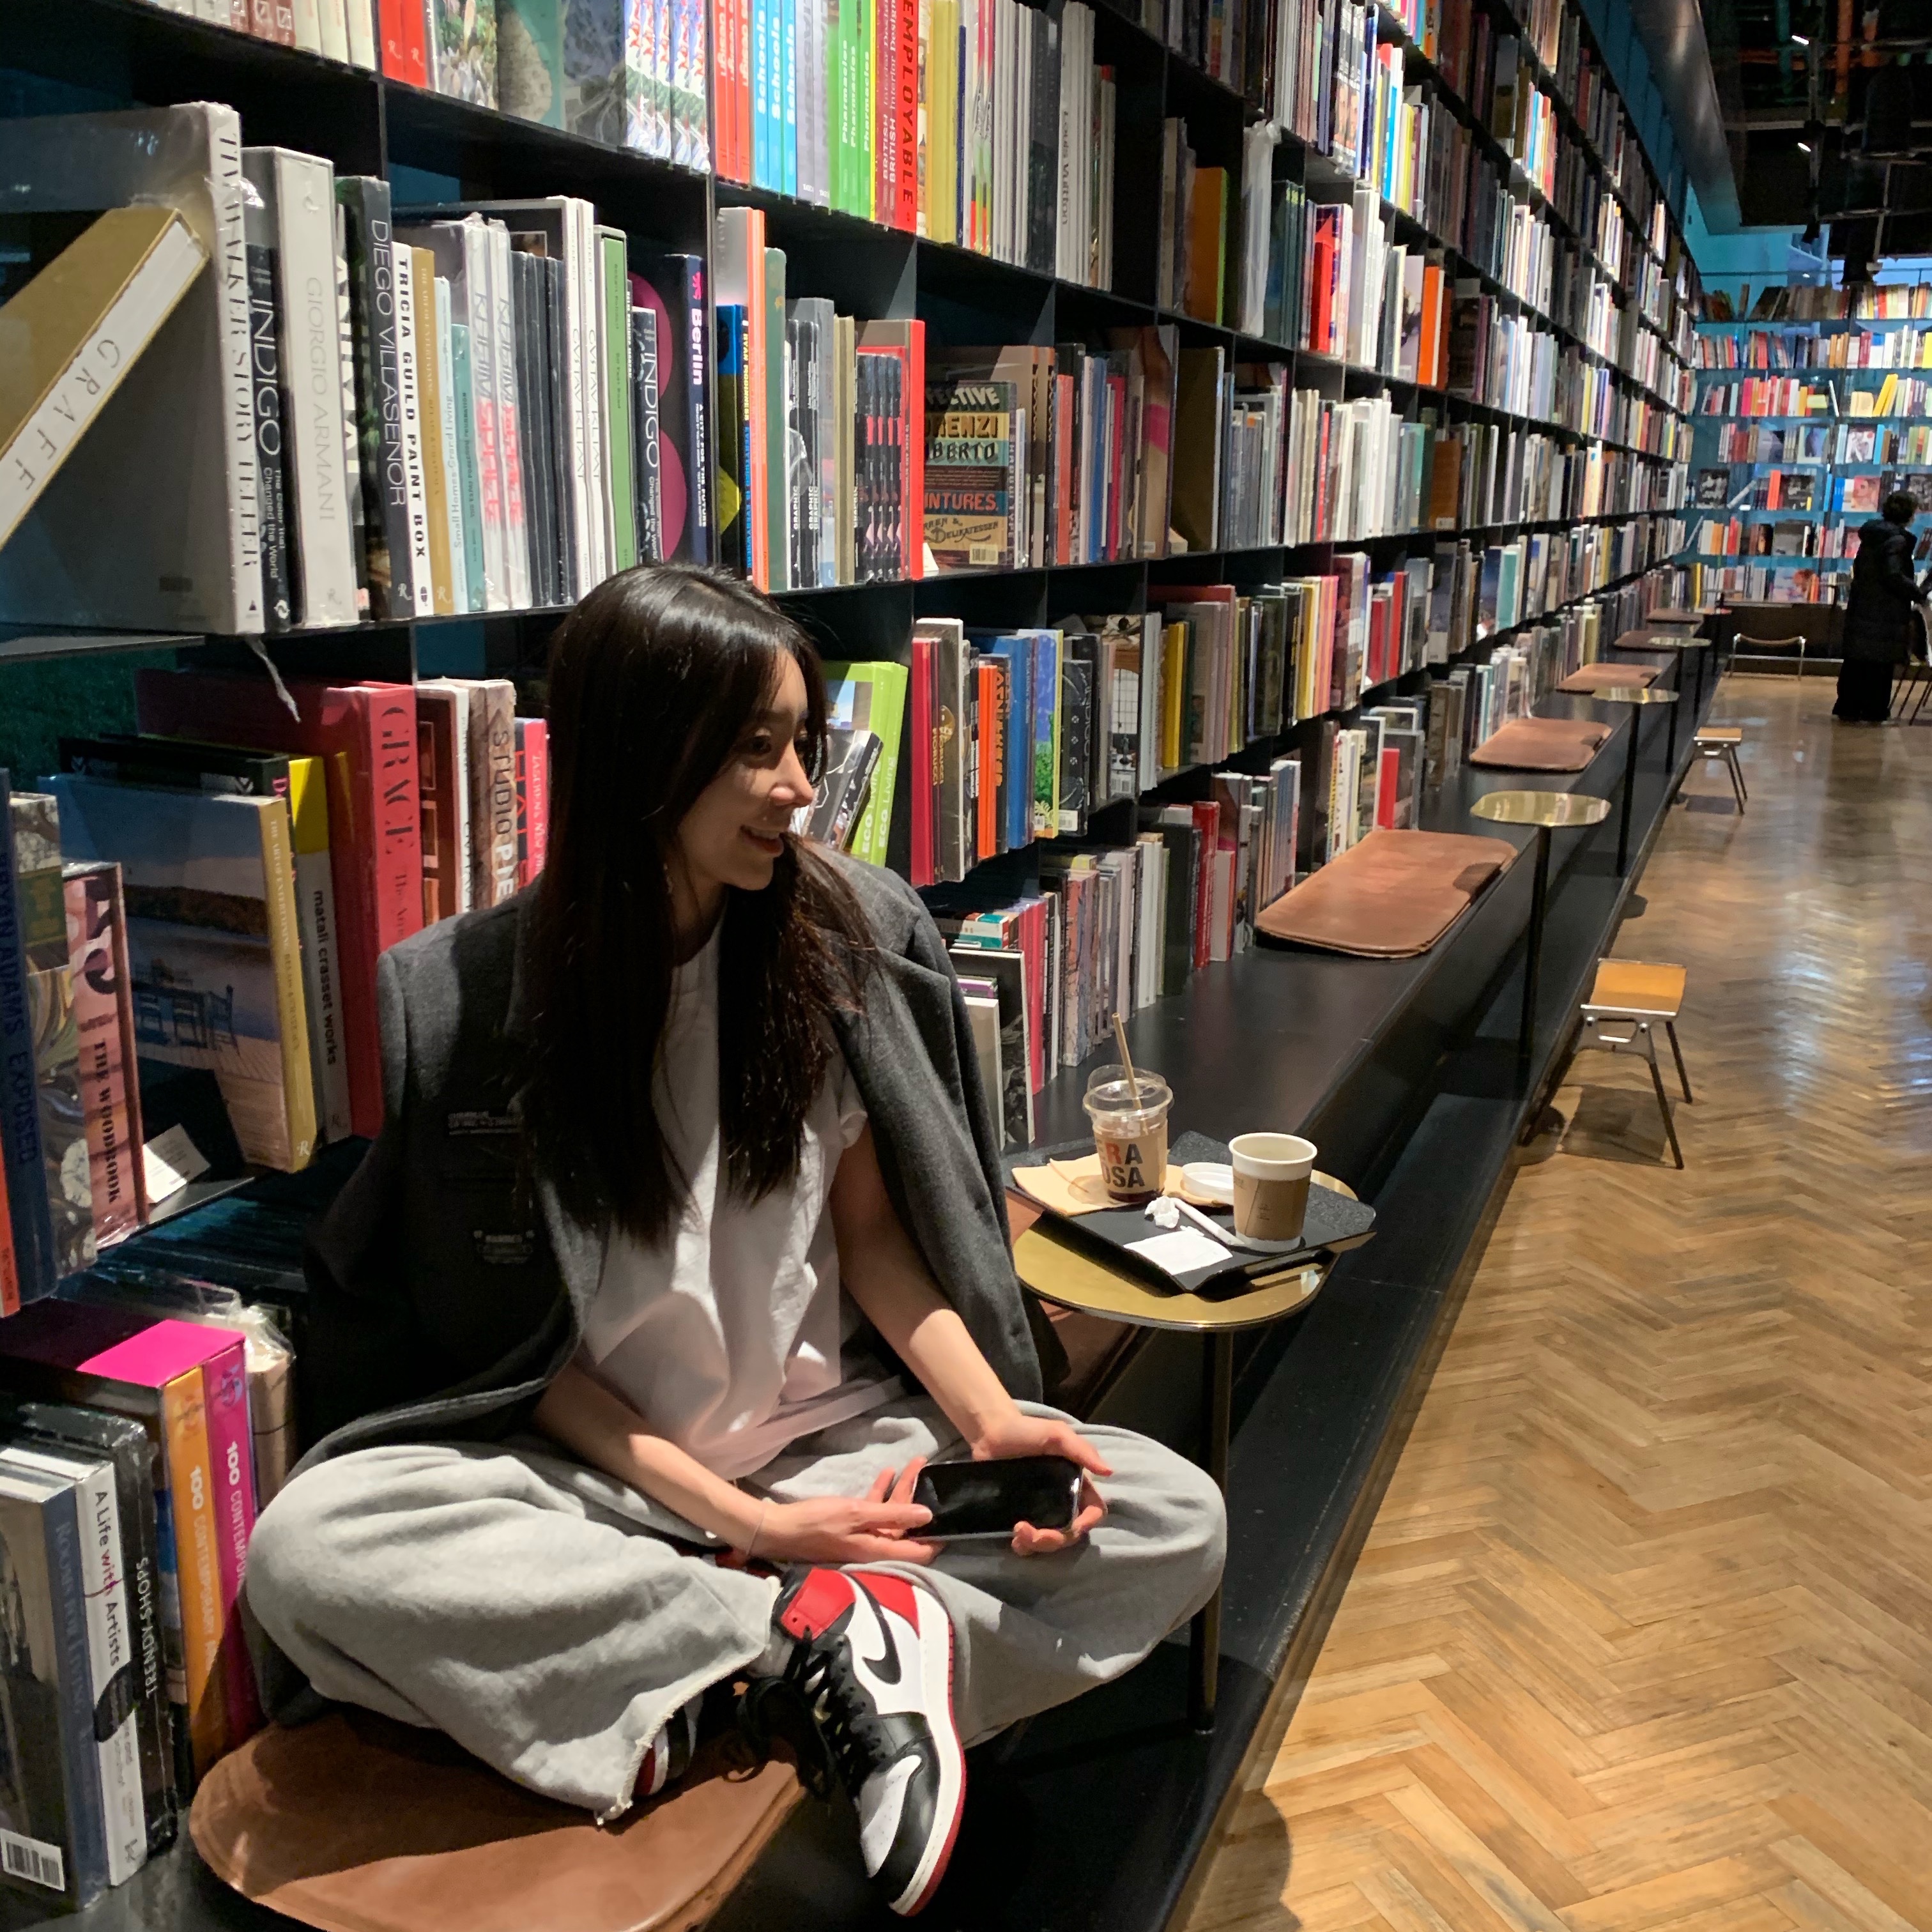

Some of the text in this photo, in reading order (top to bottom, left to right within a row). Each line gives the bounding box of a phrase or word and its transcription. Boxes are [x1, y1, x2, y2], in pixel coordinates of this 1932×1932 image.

[757, 10, 766, 114] Schools
[771, 17, 781, 119] Schools
[786, 24, 795, 125] Schools
[902, 0, 914, 204] EMPLOYABLE
[233, 351, 252, 442] STORY
[252, 299, 282, 456] INDIGO
[306, 277, 335, 521] GIORGIO ARMANI
[371, 219, 406, 505] DIEGO VILLASENOR
[691, 308, 703, 385] Berlin
[15, 339, 121, 491] GRAFF
[399, 258, 425, 557] TRICIA GUILD PAINT BOX
[643, 352, 659, 468] INDIGO
[263, 466, 279, 578] Changed the World
[452, 516, 463, 548] Small
[381, 706, 415, 855] GRACE
[494, 730, 512, 836] STUDIO
[862, 814, 873, 854] ECO
[868, 761, 882, 809] Living
[878, 756, 897, 848] ECO Living
[313, 889, 339, 1064] matali crasset works
[94, 1041, 109, 1084] THE
[188, 1464, 204, 1510] 100
[226, 1440, 241, 1486] 100
[95, 1491, 121, 1667] A Life with Artists
[192, 1514, 214, 1634] CONTEMPORARY
